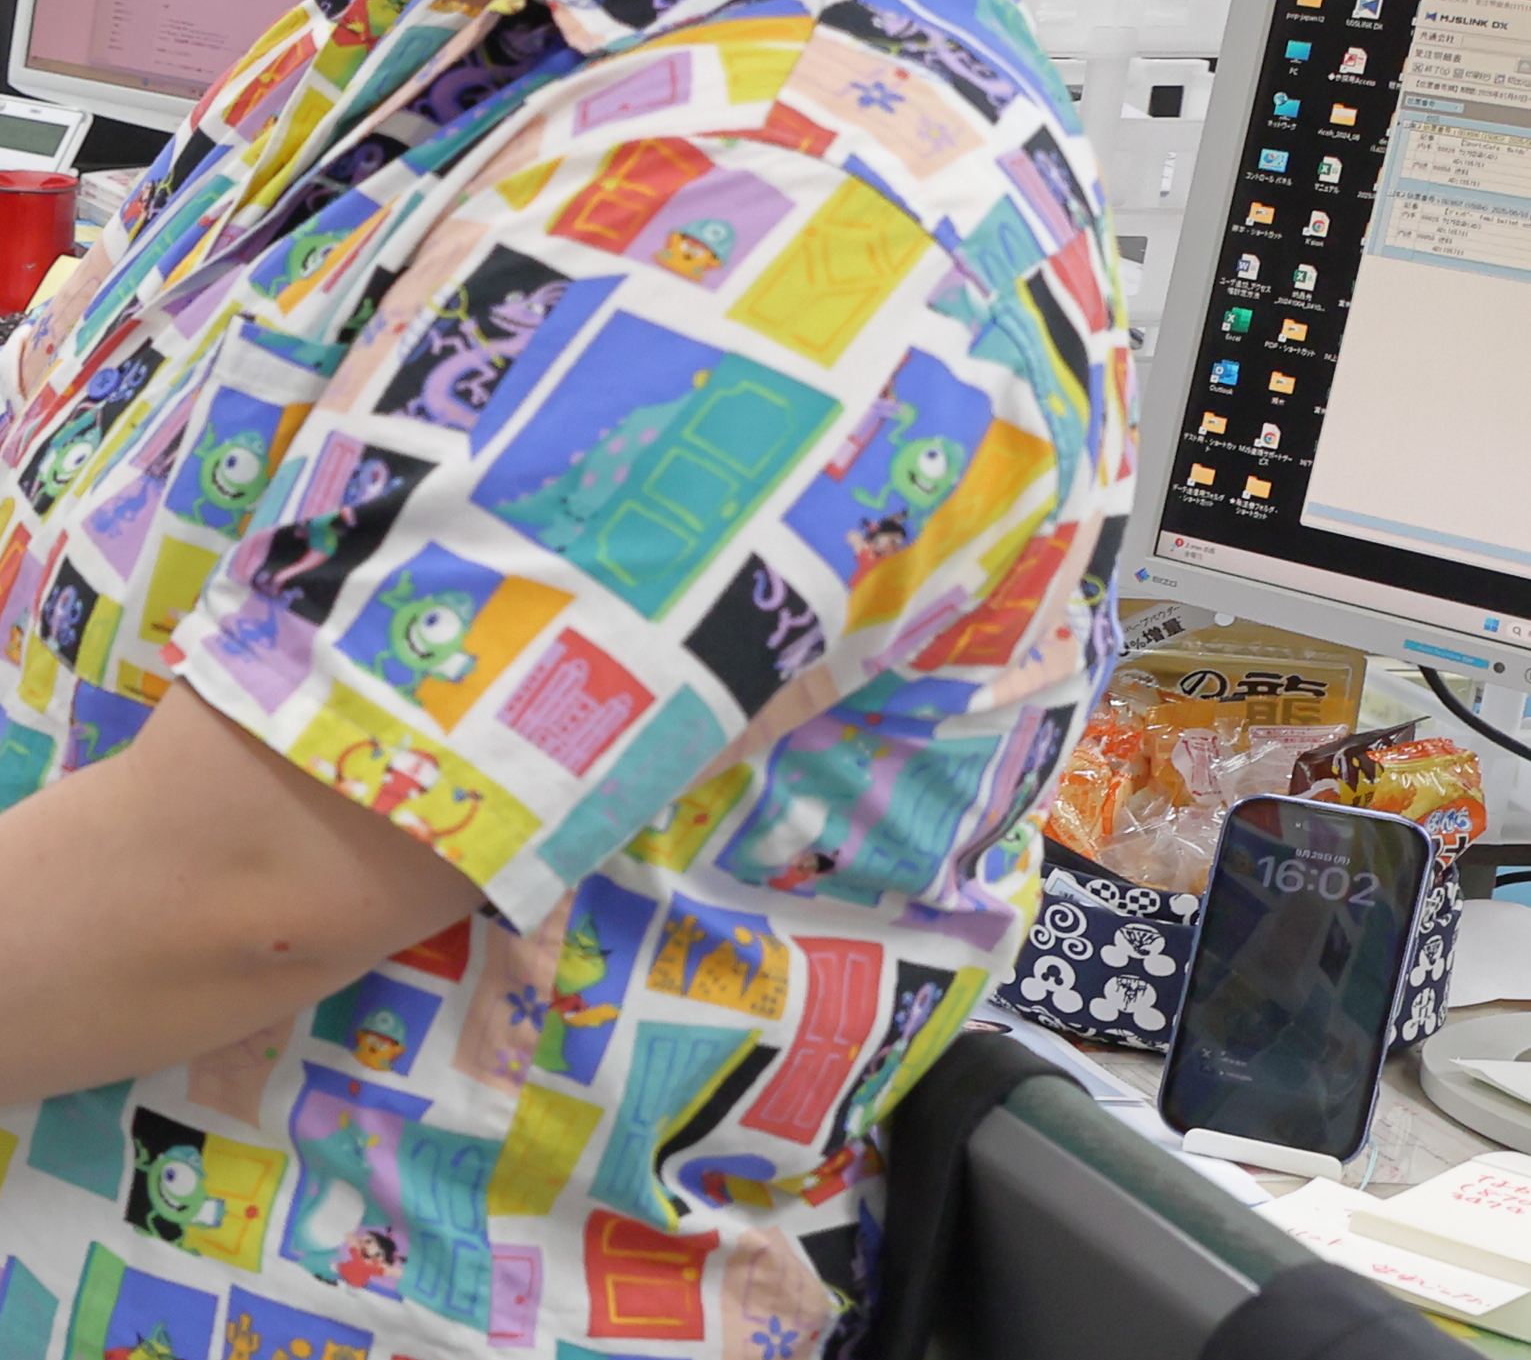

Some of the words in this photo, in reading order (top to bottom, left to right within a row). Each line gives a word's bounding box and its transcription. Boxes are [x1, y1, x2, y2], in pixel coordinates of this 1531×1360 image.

[1439, 14, 1489, 28] MJSLINK
[1491, 21, 1510, 30] DX
[1225, 334, 1241, 342] Excel
[1209, 385, 1233, 395] Outlook
[1152, 577, 1177, 588] EIZO
[1258, 856, 1381, 907] 16:02
